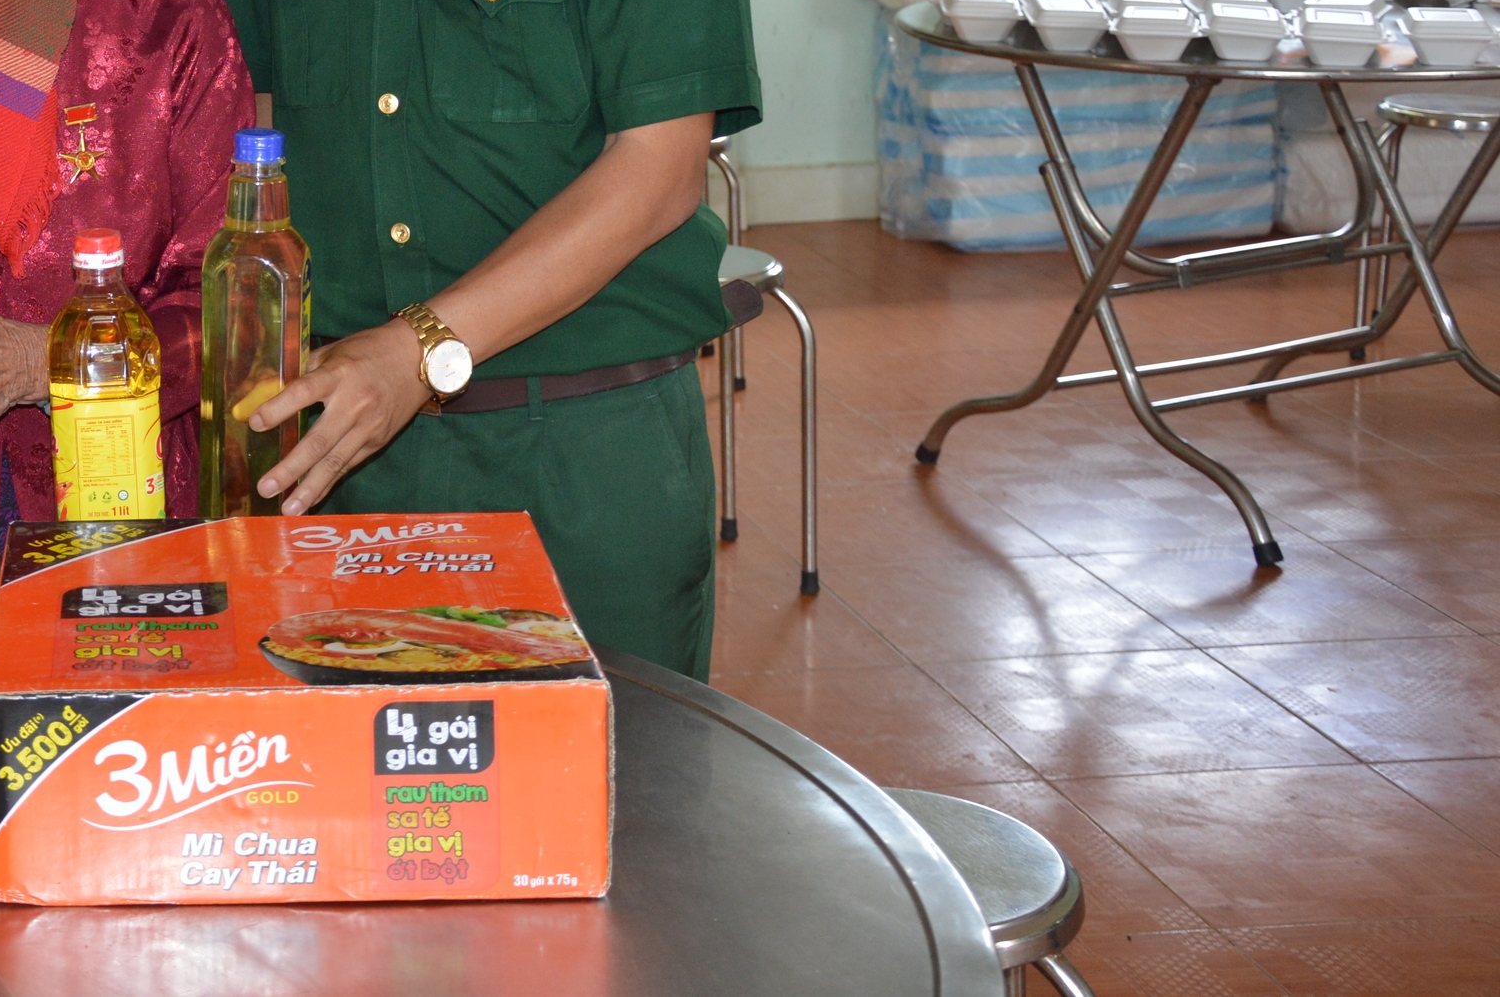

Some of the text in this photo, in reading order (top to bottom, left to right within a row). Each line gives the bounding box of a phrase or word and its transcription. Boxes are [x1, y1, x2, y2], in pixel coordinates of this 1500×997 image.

[337, 551, 493, 565] Mì Chua
[334, 561, 496, 576] Cay Thái
[81, 588, 203, 605] 4 gói
[78, 602, 204, 617] gia vị
[76, 621, 132, 632] rau
[75, 633, 120, 644] sa
[74, 644, 183, 659] gia vị
[386, 708, 478, 745] 4 gói
[385, 742, 479, 771] gia vị
[246, 790, 300, 804] GOLD
[386, 781, 489, 804] rau thơm
[386, 805, 452, 829] sa tế
[181, 831, 318, 857] Mì Chua
[386, 831, 463, 857] gia vị
[179, 860, 319, 890] Cay Thái
[386, 858, 470, 885] ớt bột
[513, 874, 529, 887] 30
[530, 875, 545, 888] gói
[547, 876, 554, 885] x
